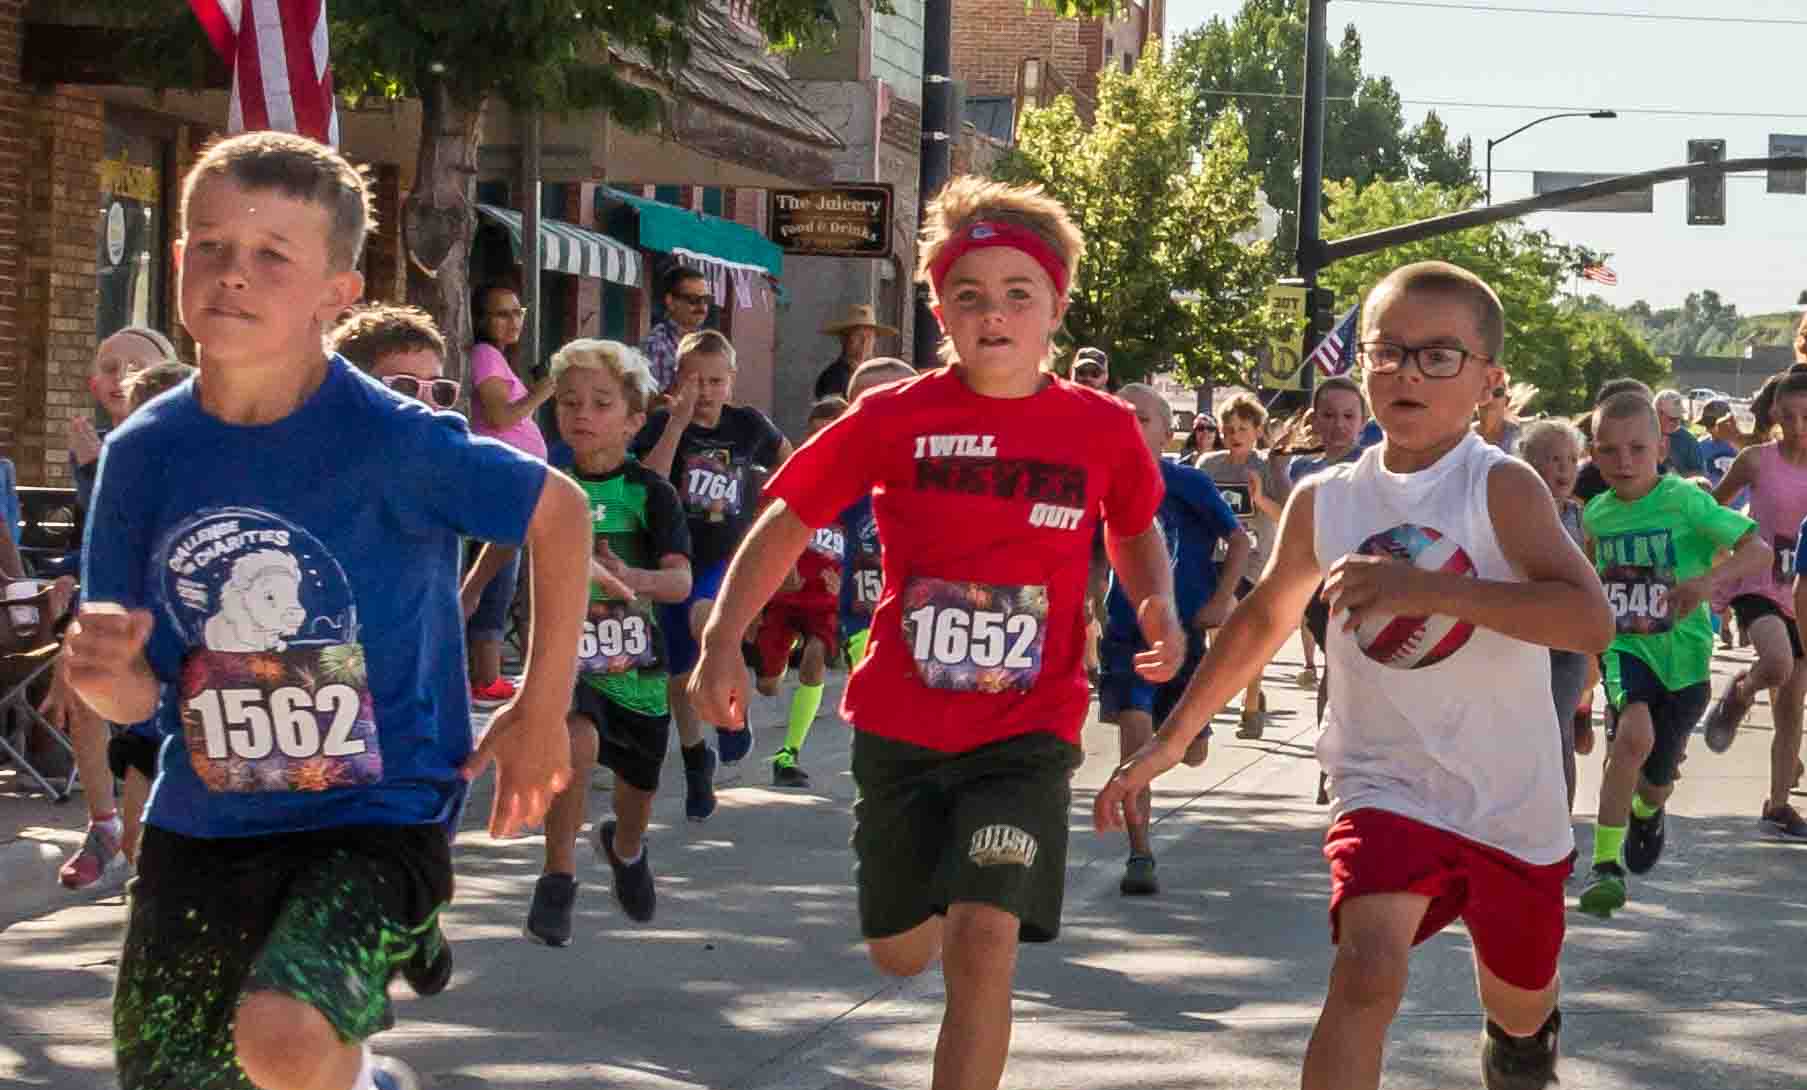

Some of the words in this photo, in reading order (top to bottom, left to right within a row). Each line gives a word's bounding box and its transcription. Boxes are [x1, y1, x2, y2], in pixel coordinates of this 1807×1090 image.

[776, 194, 812, 209] The
[914, 436, 927, 459] I
[929, 434, 998, 457] WILL
[688, 468, 738, 503] 1764
[914, 459, 1088, 510] NEVER
[1028, 502, 1085, 530] QUIT
[910, 604, 1037, 668] 1652
[189, 684, 366, 759] 1562
